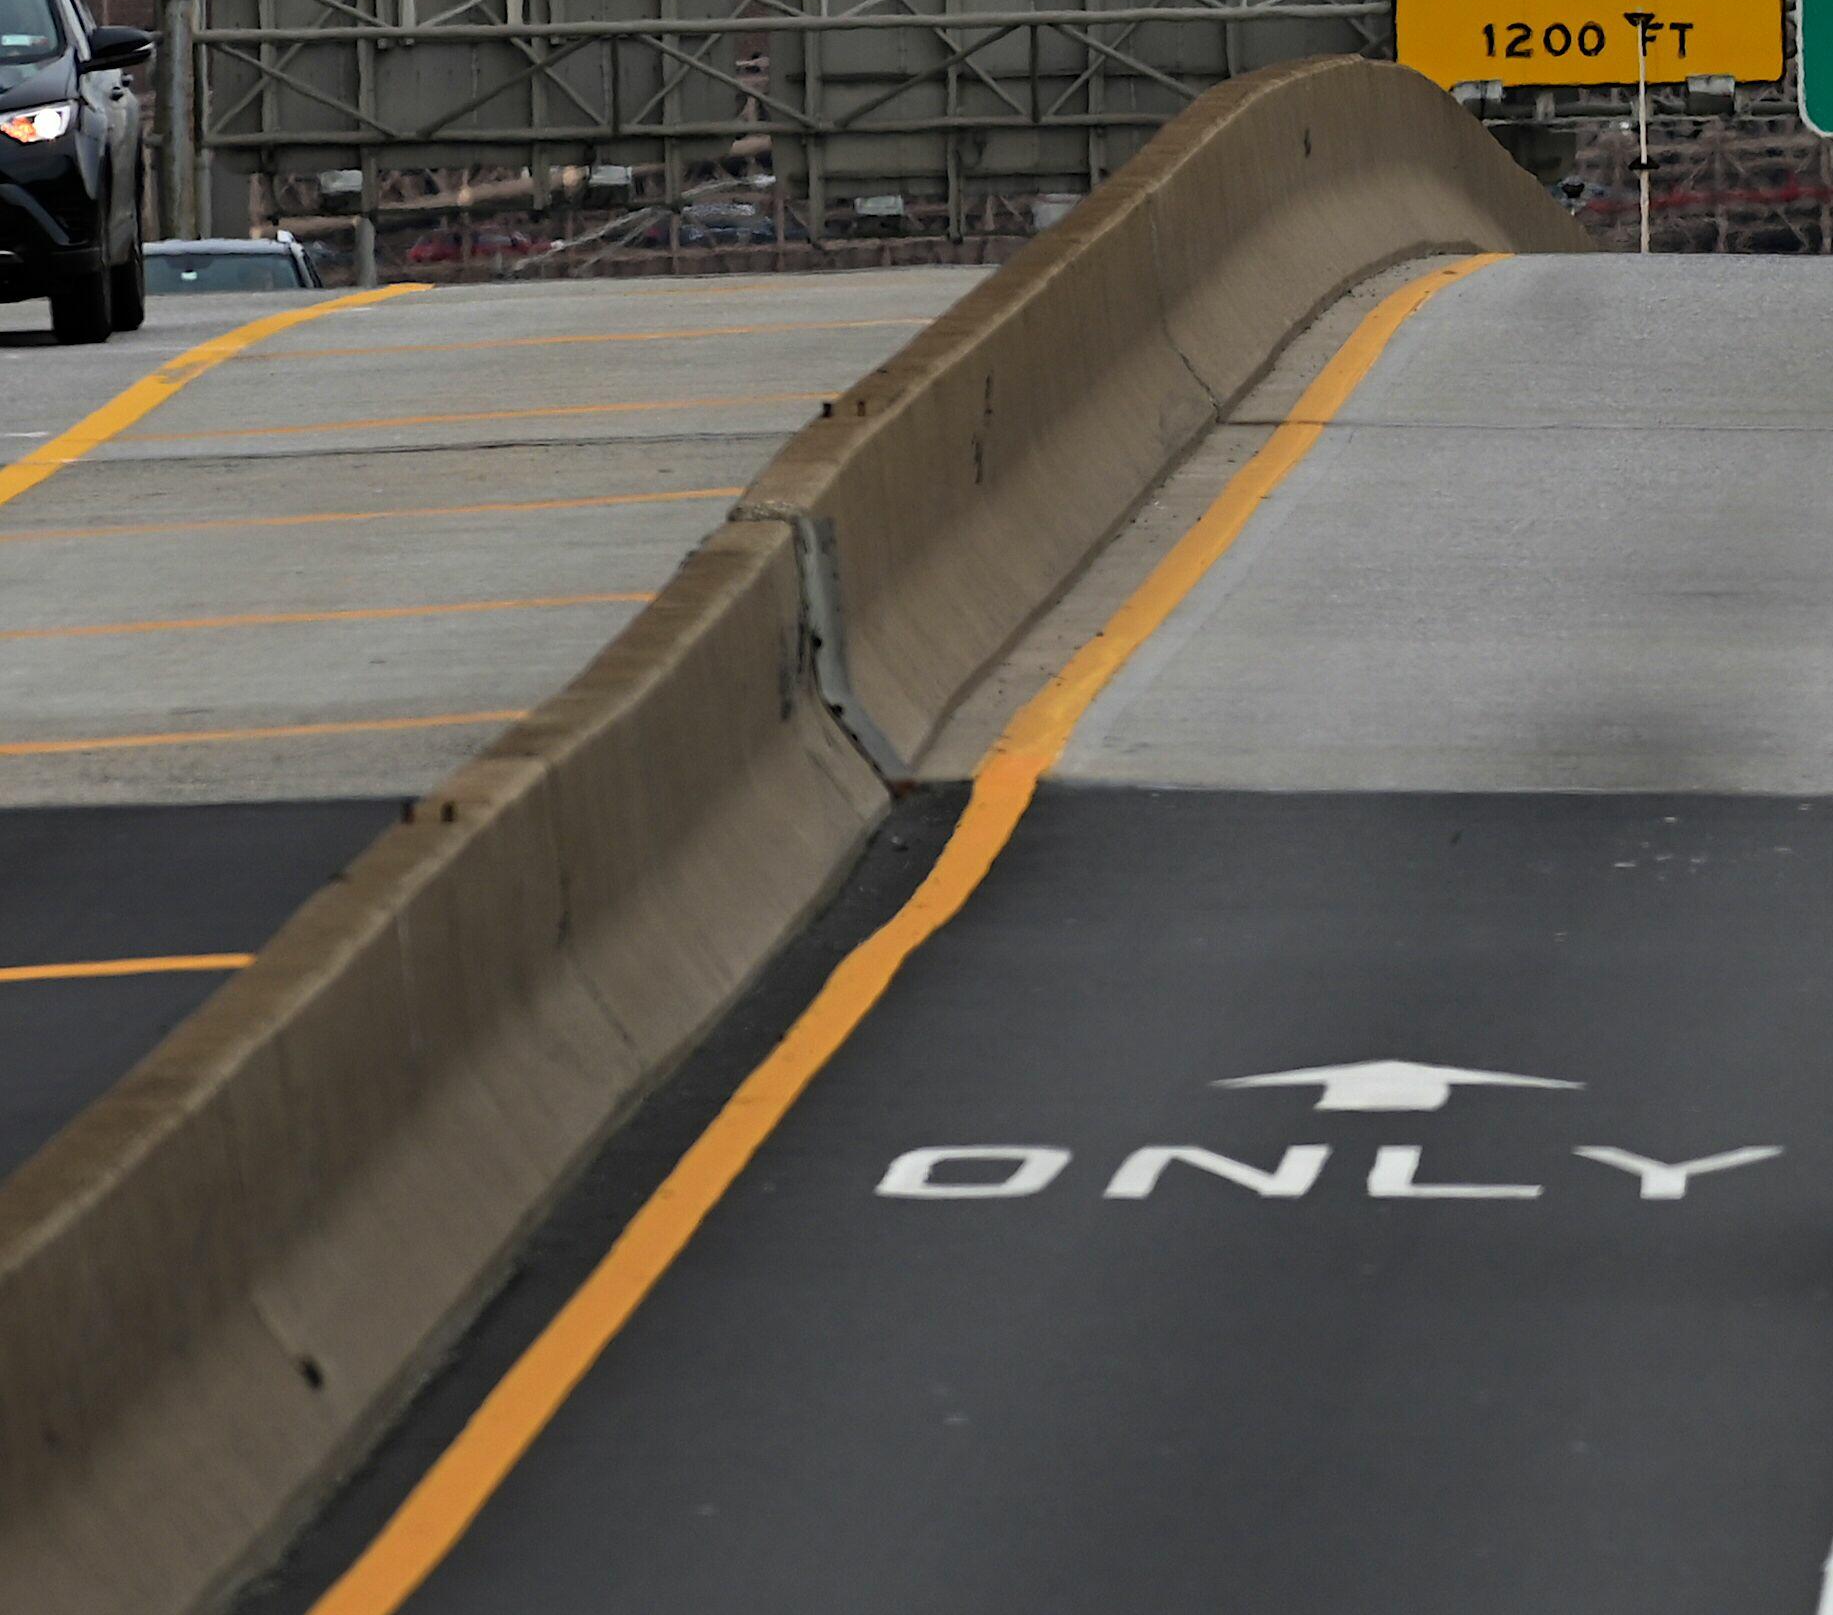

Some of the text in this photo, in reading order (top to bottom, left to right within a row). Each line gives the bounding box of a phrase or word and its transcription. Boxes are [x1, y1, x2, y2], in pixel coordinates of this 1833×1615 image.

[1484, 22, 1694, 58] 1200 FT
[876, 1144, 1783, 1199] ONLY
